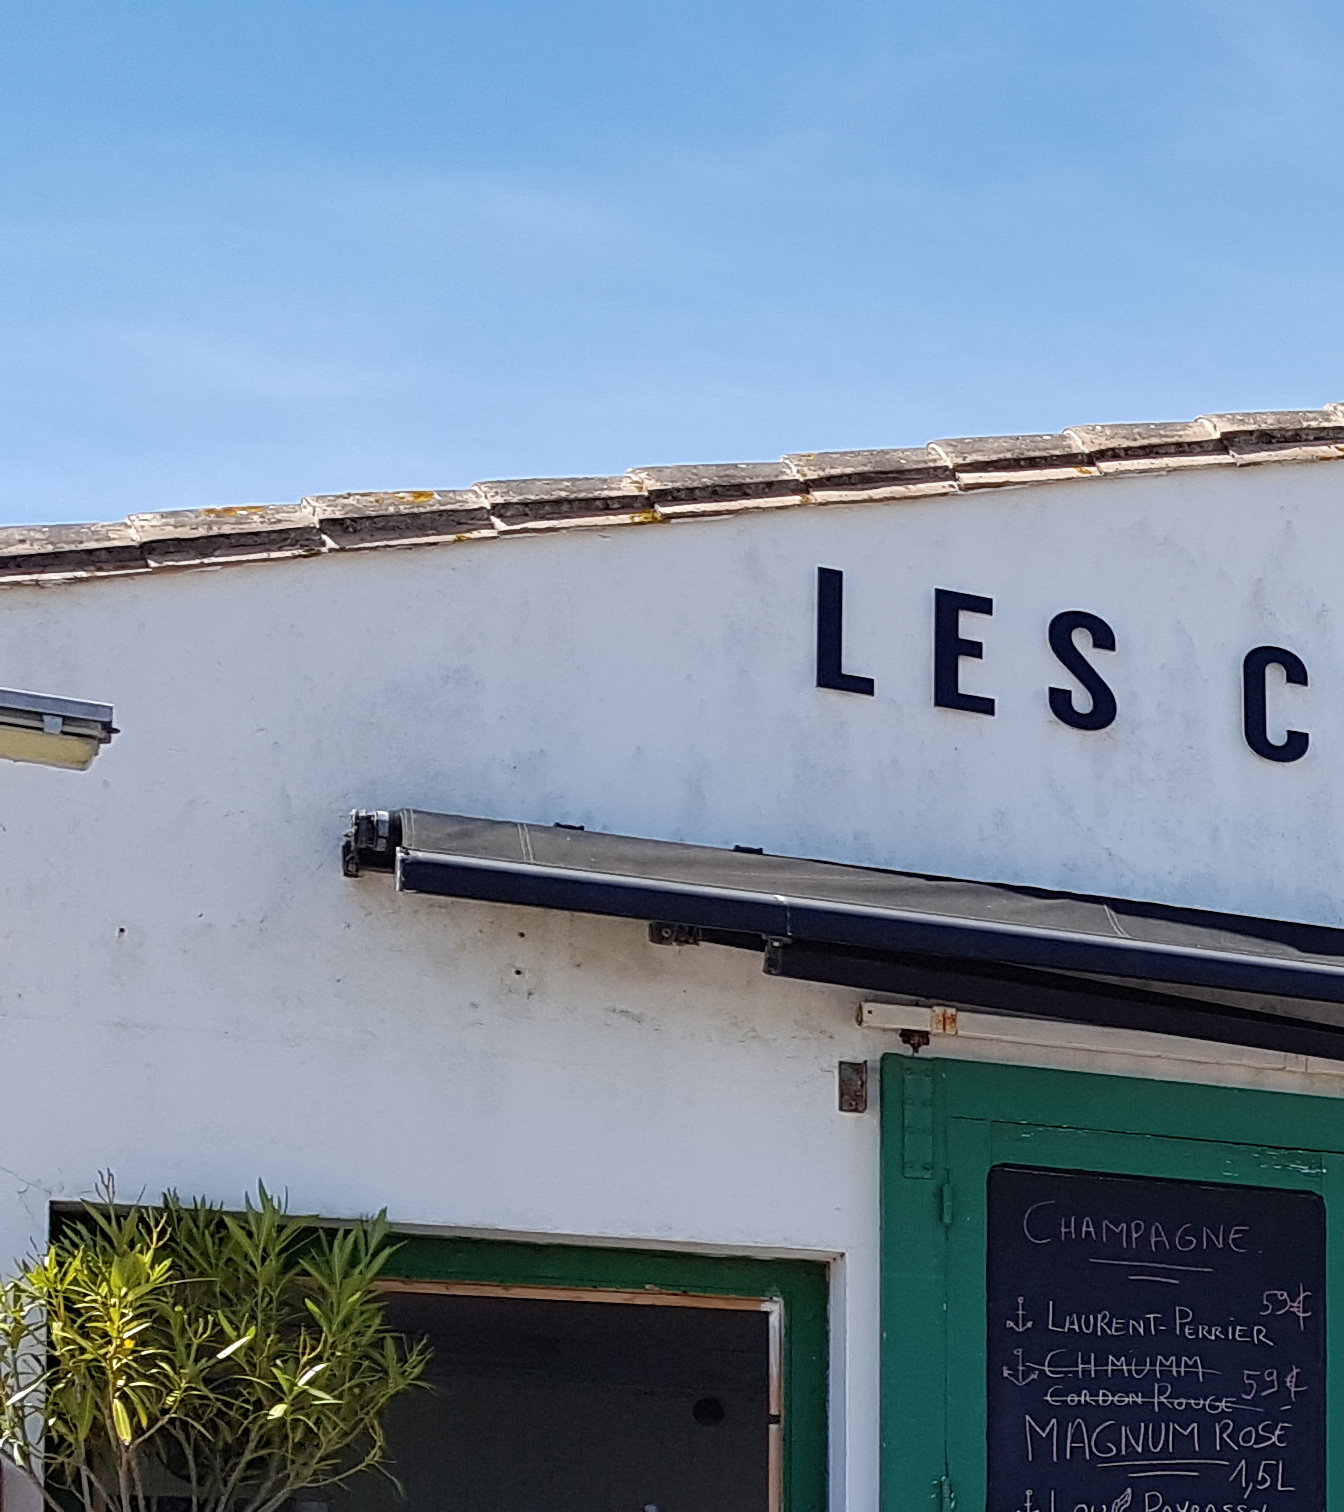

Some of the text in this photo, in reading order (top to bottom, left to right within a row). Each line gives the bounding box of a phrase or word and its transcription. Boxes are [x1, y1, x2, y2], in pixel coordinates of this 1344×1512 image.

[815, 566, 1119, 732] LES
[1024, 1201, 1250, 1253] CHAMPAGNE
[1260, 1283, 1312, 1331] 59€
[1109, 1354, 1204, 1382] MUMM
[1047, 1383, 1237, 1413] CORDON ROUGE
[1025, 1414, 1199, 1462] MAGNUM
[1229, 1459, 1295, 1499] 1,5L
